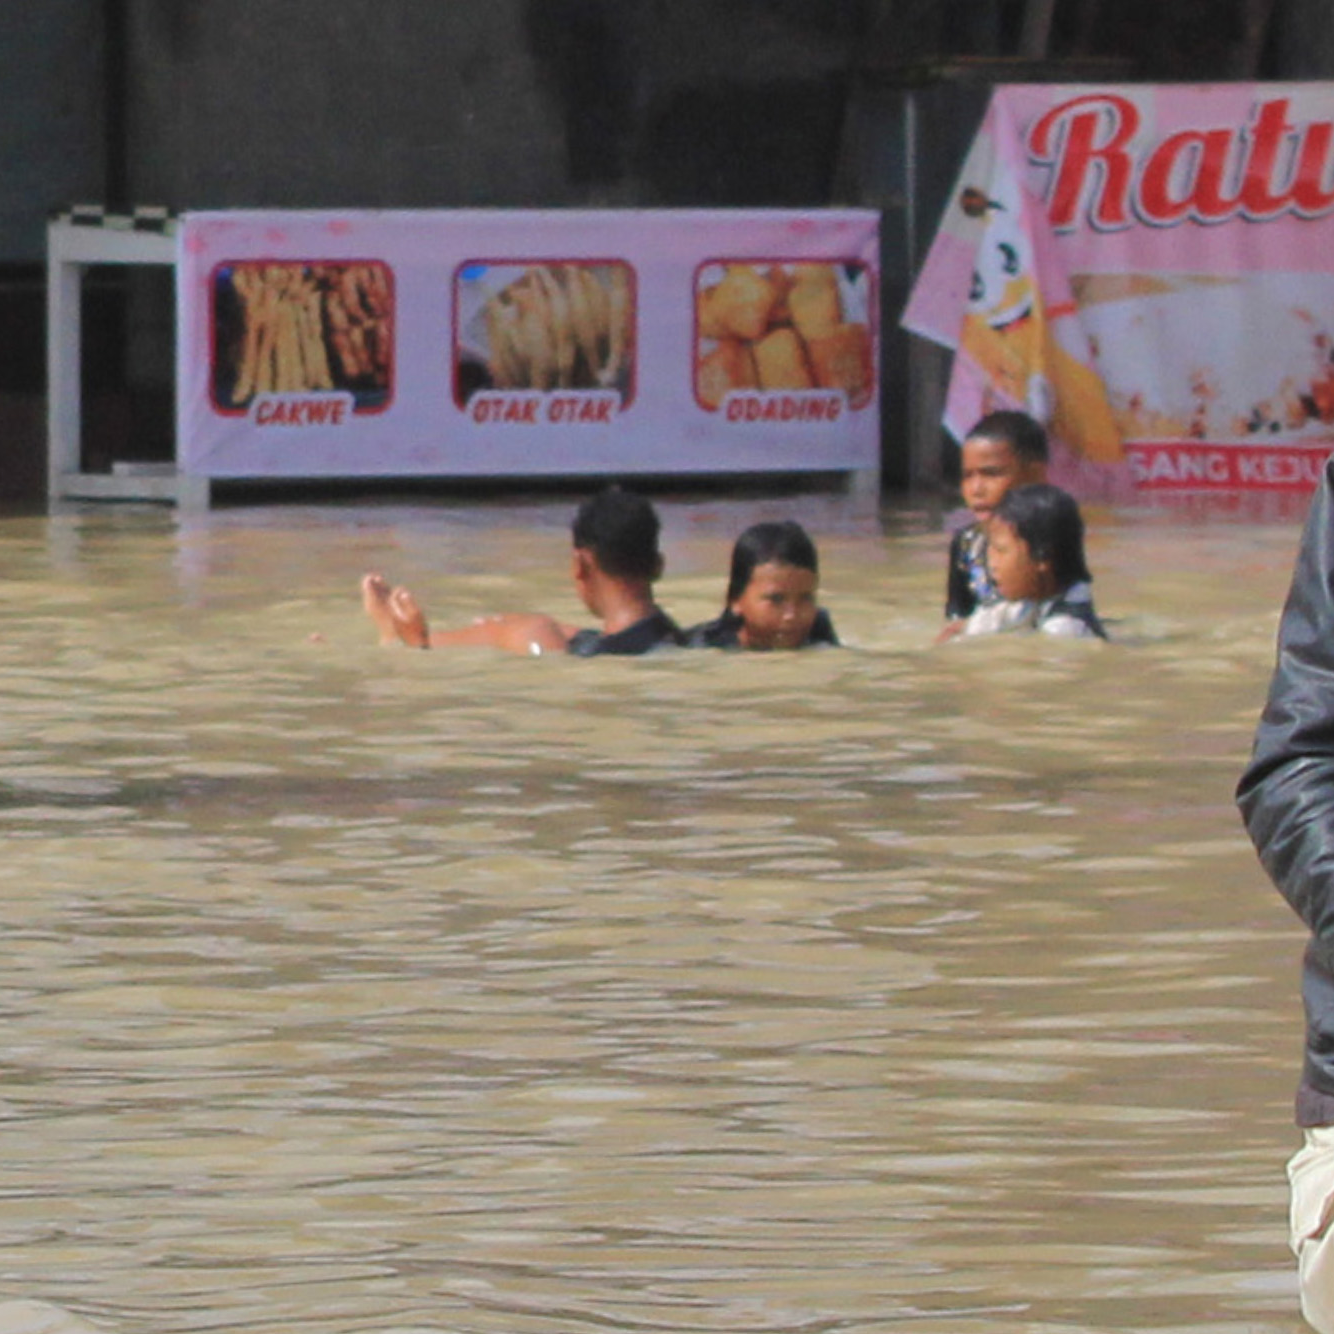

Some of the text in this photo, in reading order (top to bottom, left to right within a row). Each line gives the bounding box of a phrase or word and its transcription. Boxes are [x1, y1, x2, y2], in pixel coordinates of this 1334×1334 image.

[255, 399, 346, 426] CAKWE
[472, 396, 614, 424] OTAK OTAK
